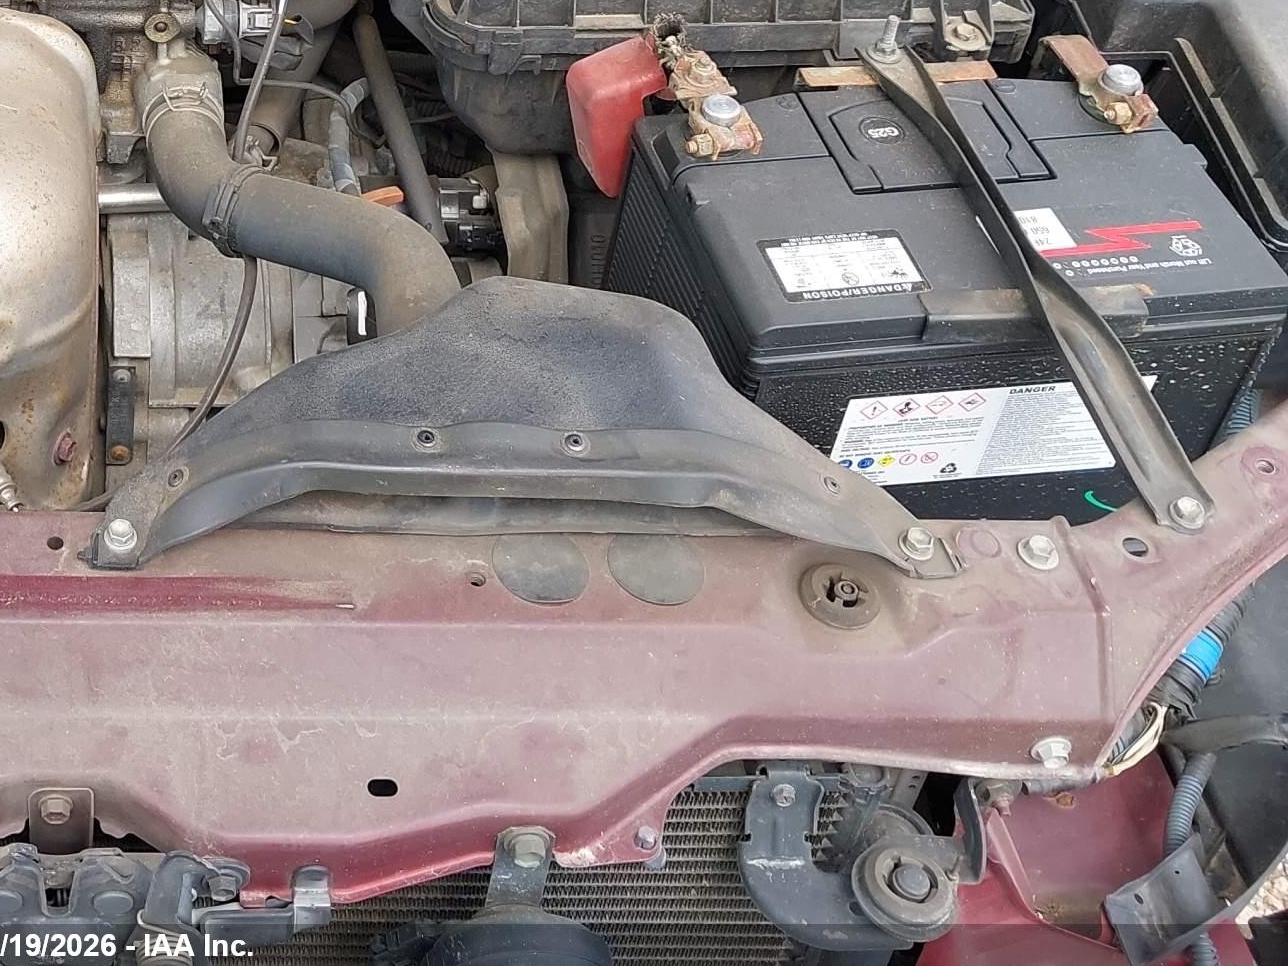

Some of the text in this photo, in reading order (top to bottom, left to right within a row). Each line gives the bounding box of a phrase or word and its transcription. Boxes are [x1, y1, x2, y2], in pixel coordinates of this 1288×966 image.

[868, 127, 899, 139] G25
[803, 285, 904, 300] DANGER/POISON
[1009, 385, 1056, 395] DANGER
